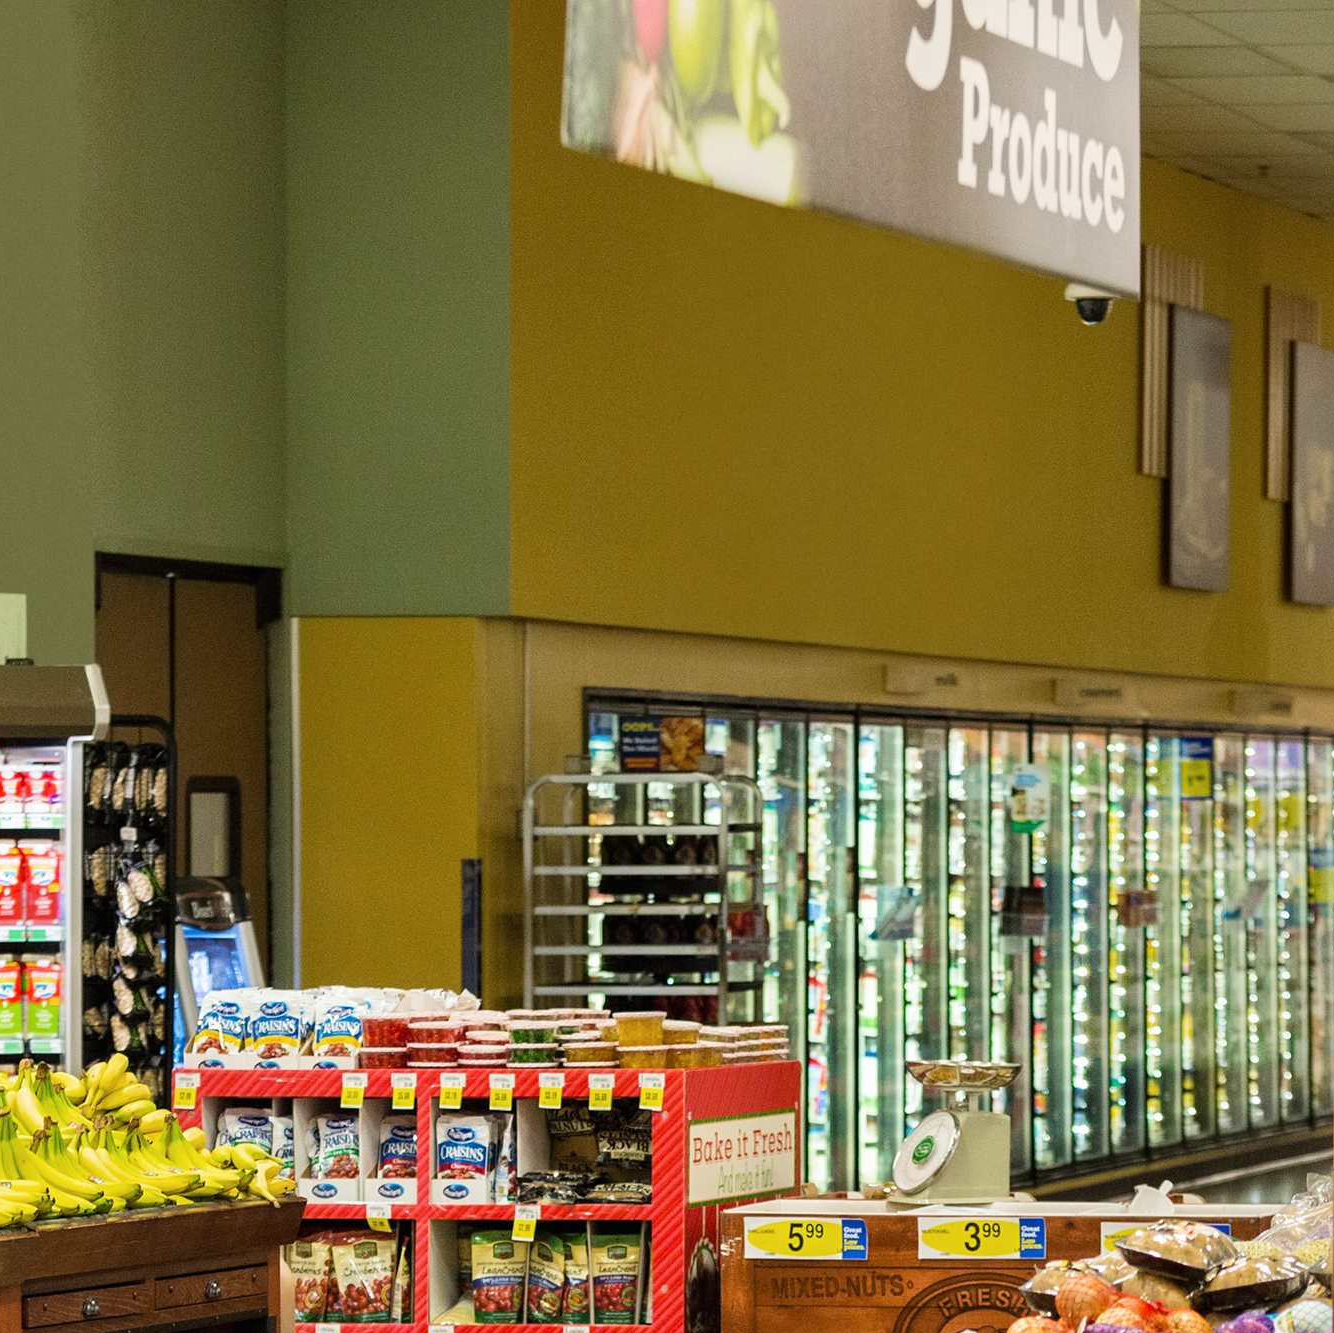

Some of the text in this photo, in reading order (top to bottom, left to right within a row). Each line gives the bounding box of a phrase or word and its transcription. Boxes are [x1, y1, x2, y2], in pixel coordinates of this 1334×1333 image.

[958, 55, 1125, 233] Produce
[440, 1144, 486, 1163] CRAISINS
[692, 1122, 793, 1164] Bake it Fresh
[771, 1273, 905, 1299] MIXED NUTS
[938, 1288, 1030, 1318] FRESH
